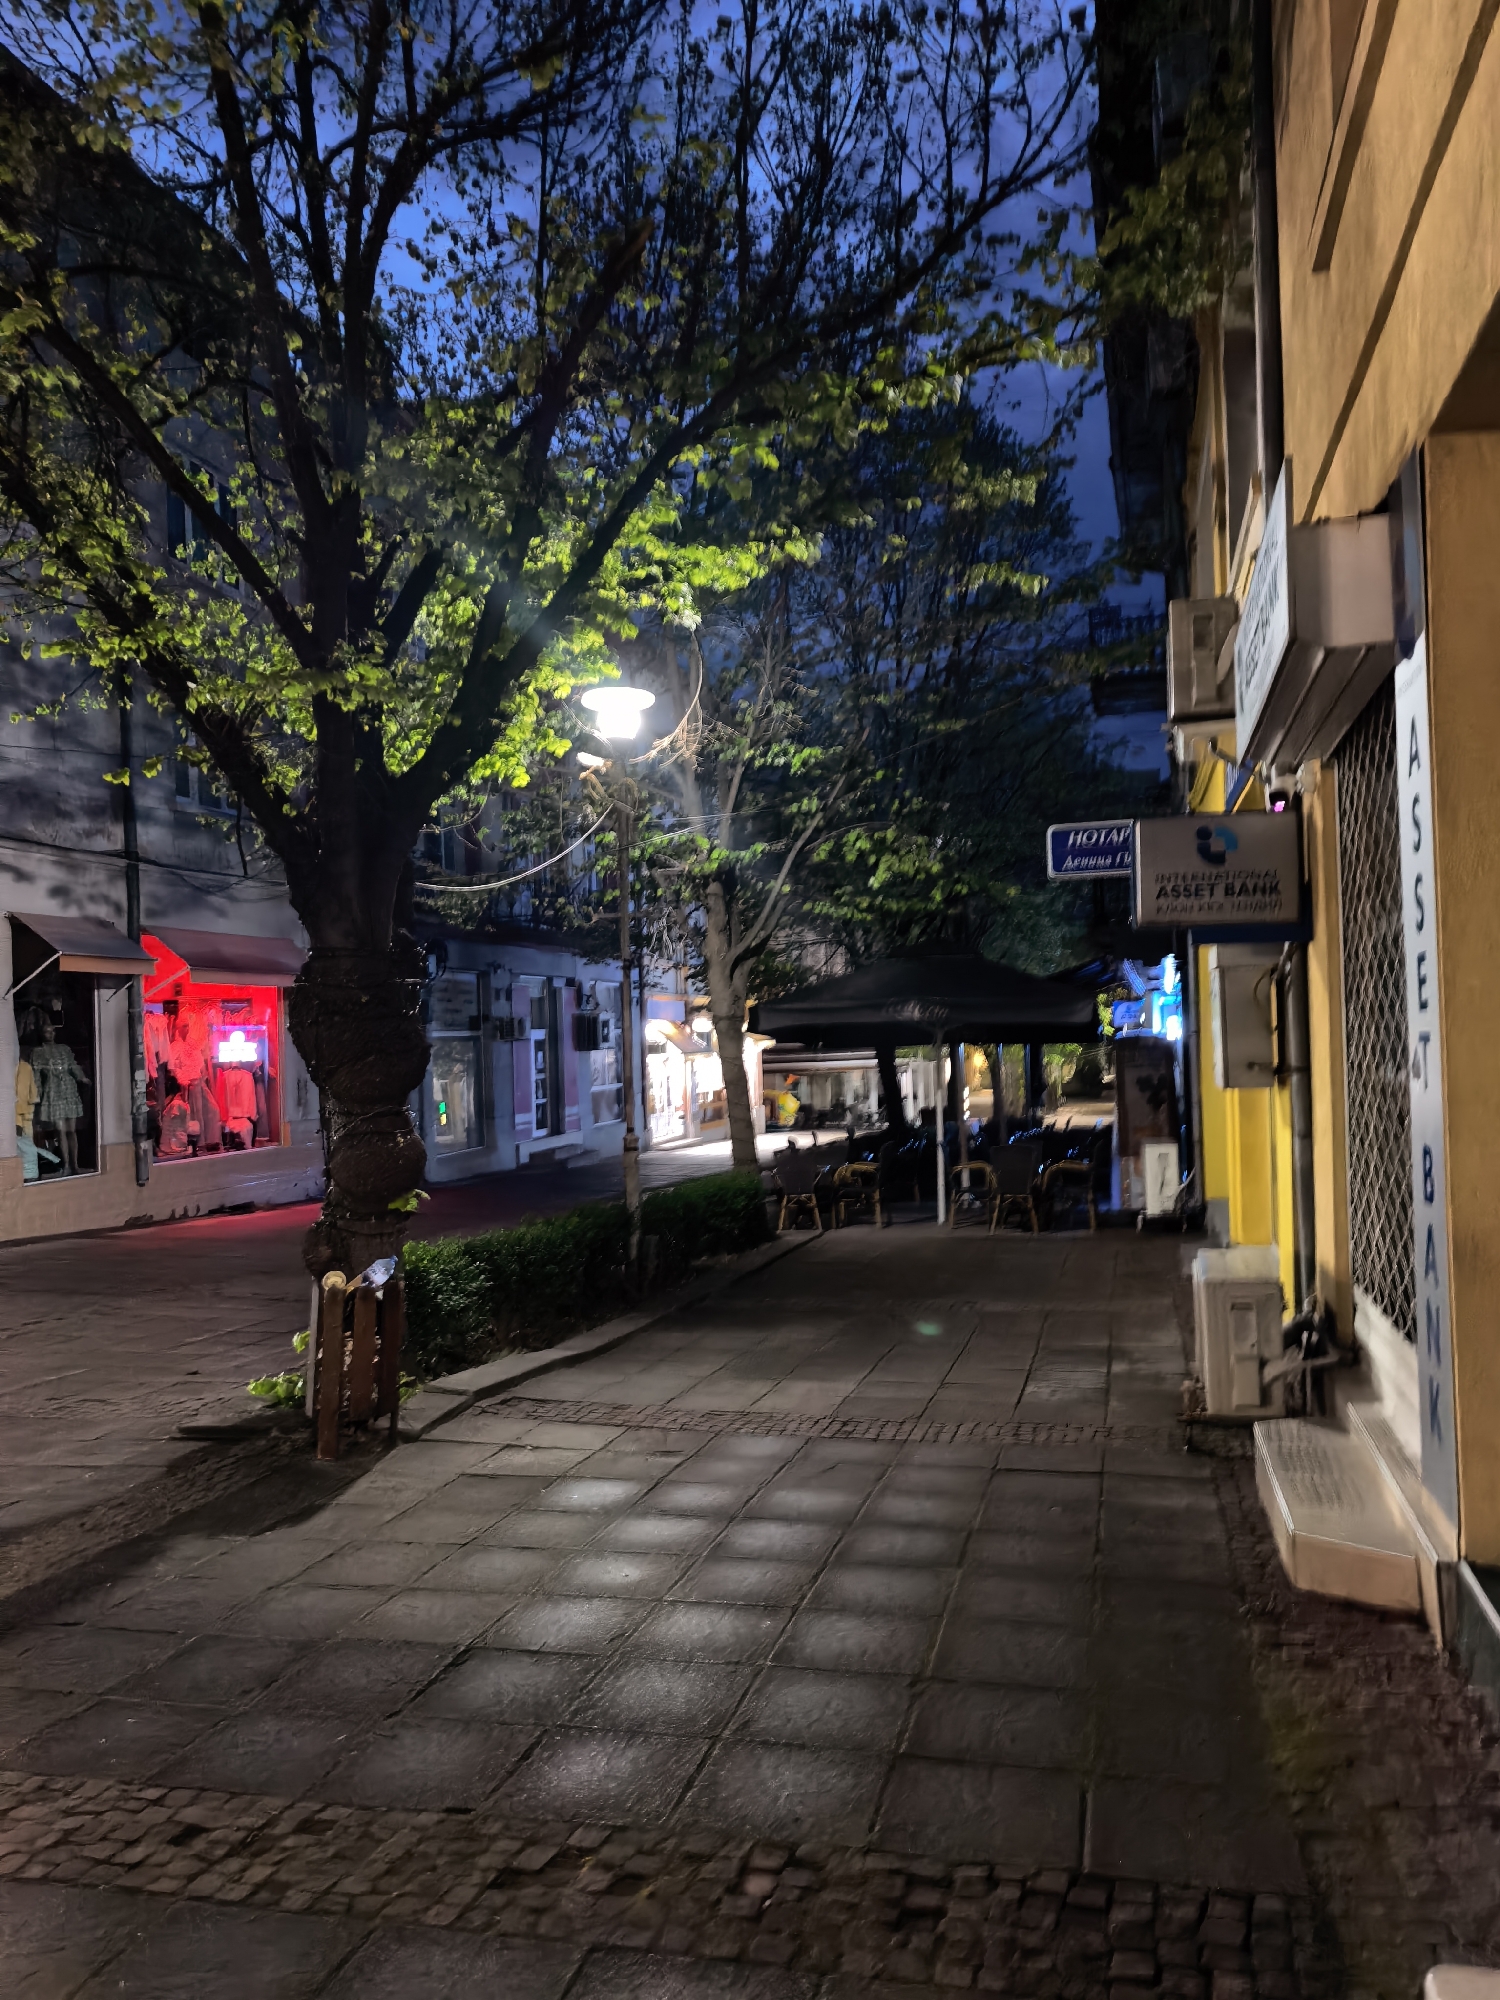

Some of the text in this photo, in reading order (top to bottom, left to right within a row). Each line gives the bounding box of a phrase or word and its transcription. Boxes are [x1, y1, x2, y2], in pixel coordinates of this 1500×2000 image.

[1155, 879, 1281, 899] ASSET BANK
[1408, 714, 1431, 1091] ASSET
[1422, 1143, 1442, 1443] BANK
